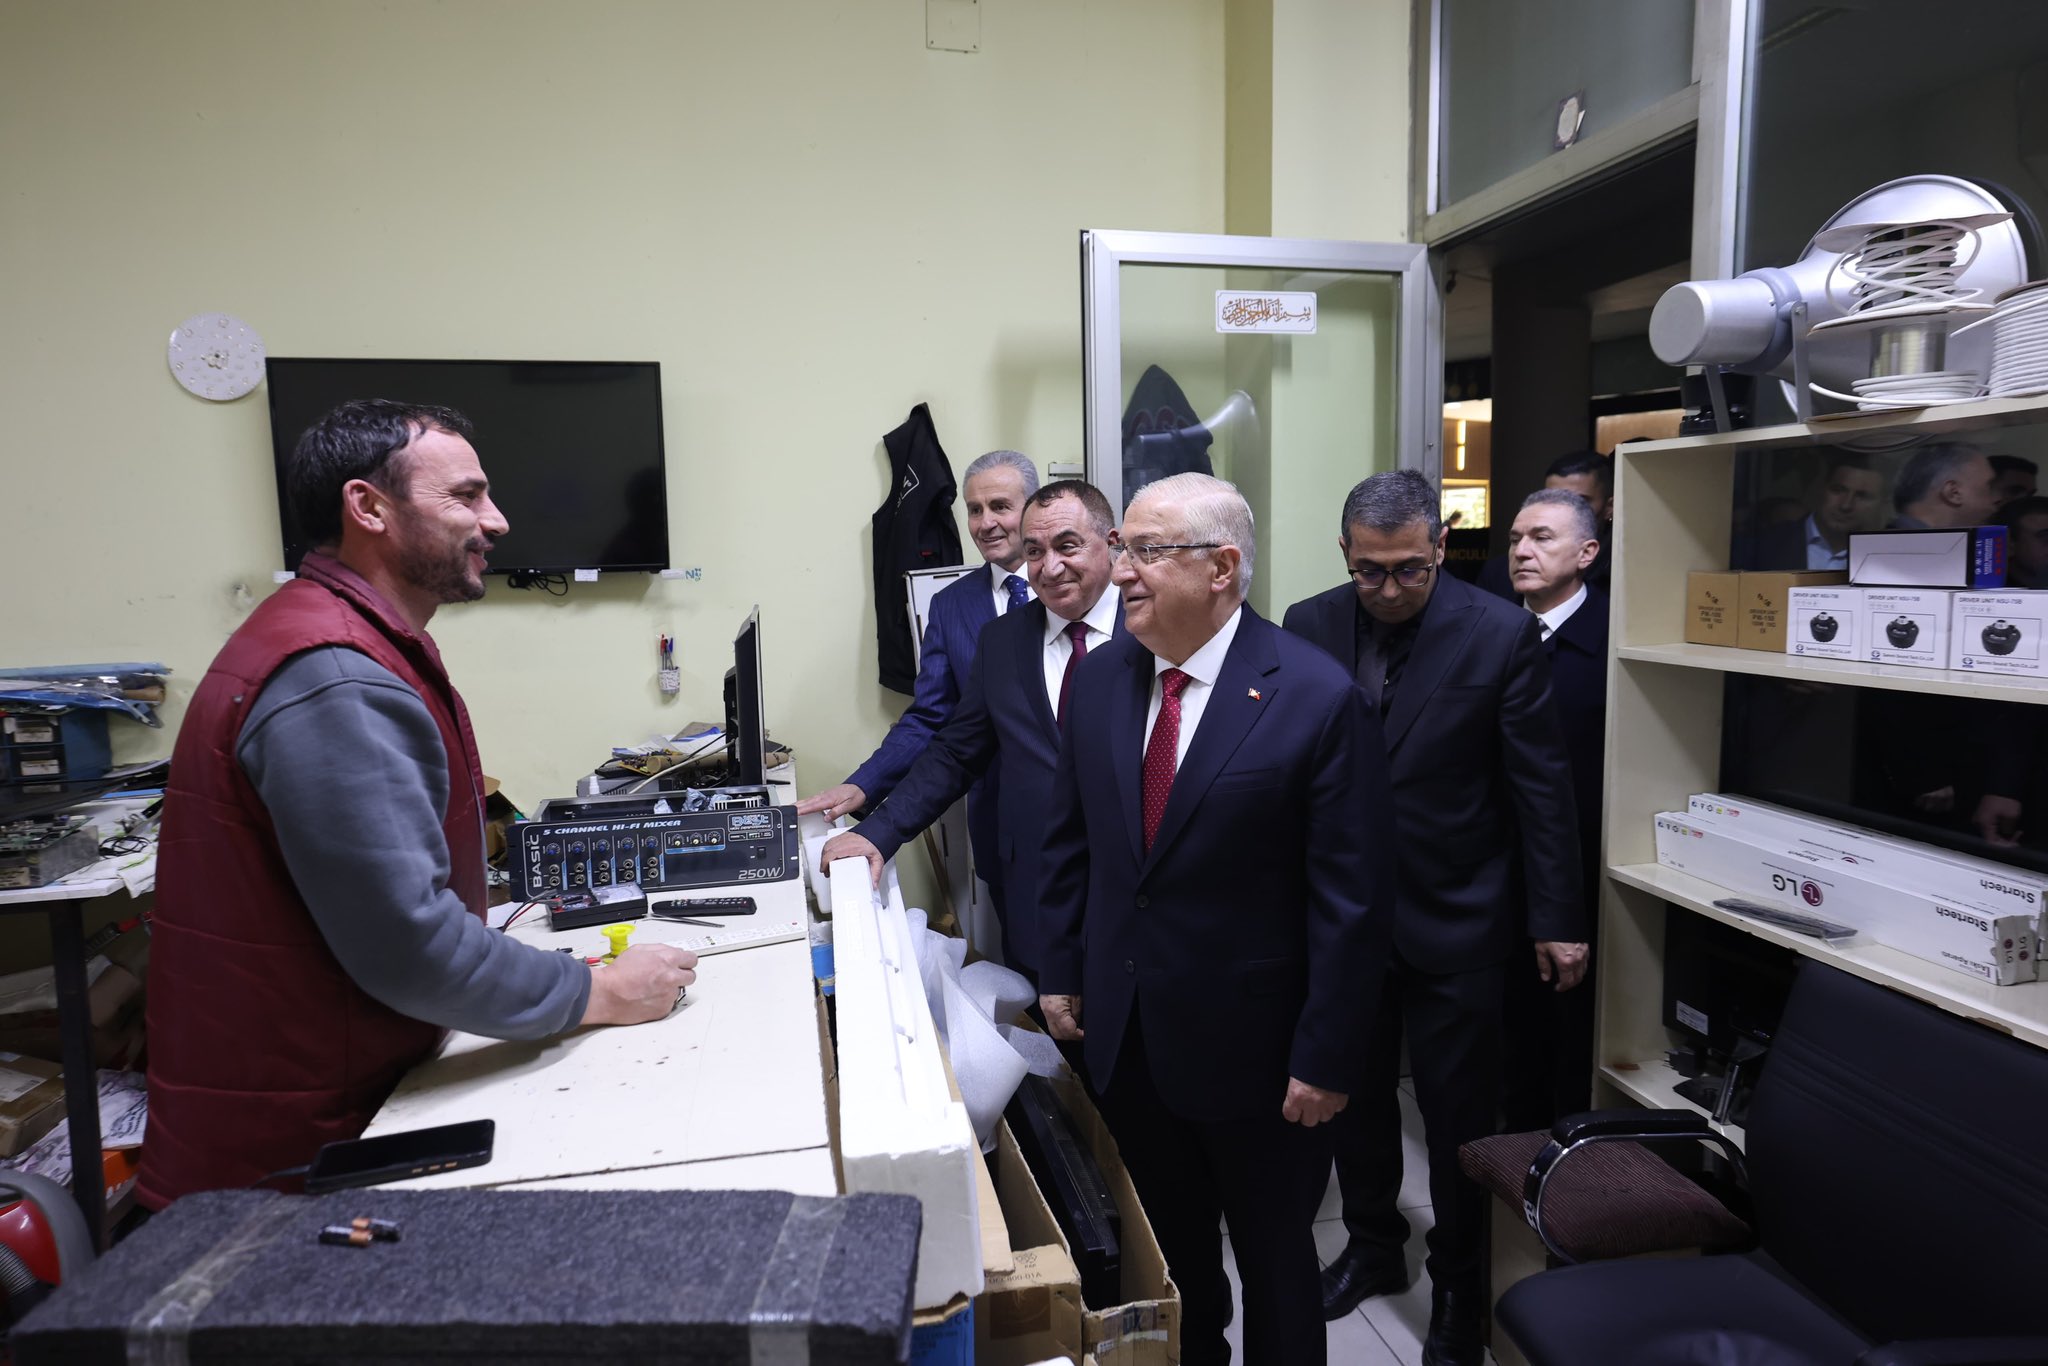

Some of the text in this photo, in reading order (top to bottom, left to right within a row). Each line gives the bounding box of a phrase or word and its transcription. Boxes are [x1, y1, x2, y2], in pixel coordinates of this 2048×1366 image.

[554, 825, 608, 834] CHANNEL
[612, 823, 640, 831] HI-FI
[643, 820, 682, 828] MIXER
[532, 834, 542, 888] BASIC
[738, 867, 782, 880] 250W
[1772, 873, 1799, 897] LG
[1980, 878, 2036, 904] Startech
[1935, 905, 1989, 932] Startech
